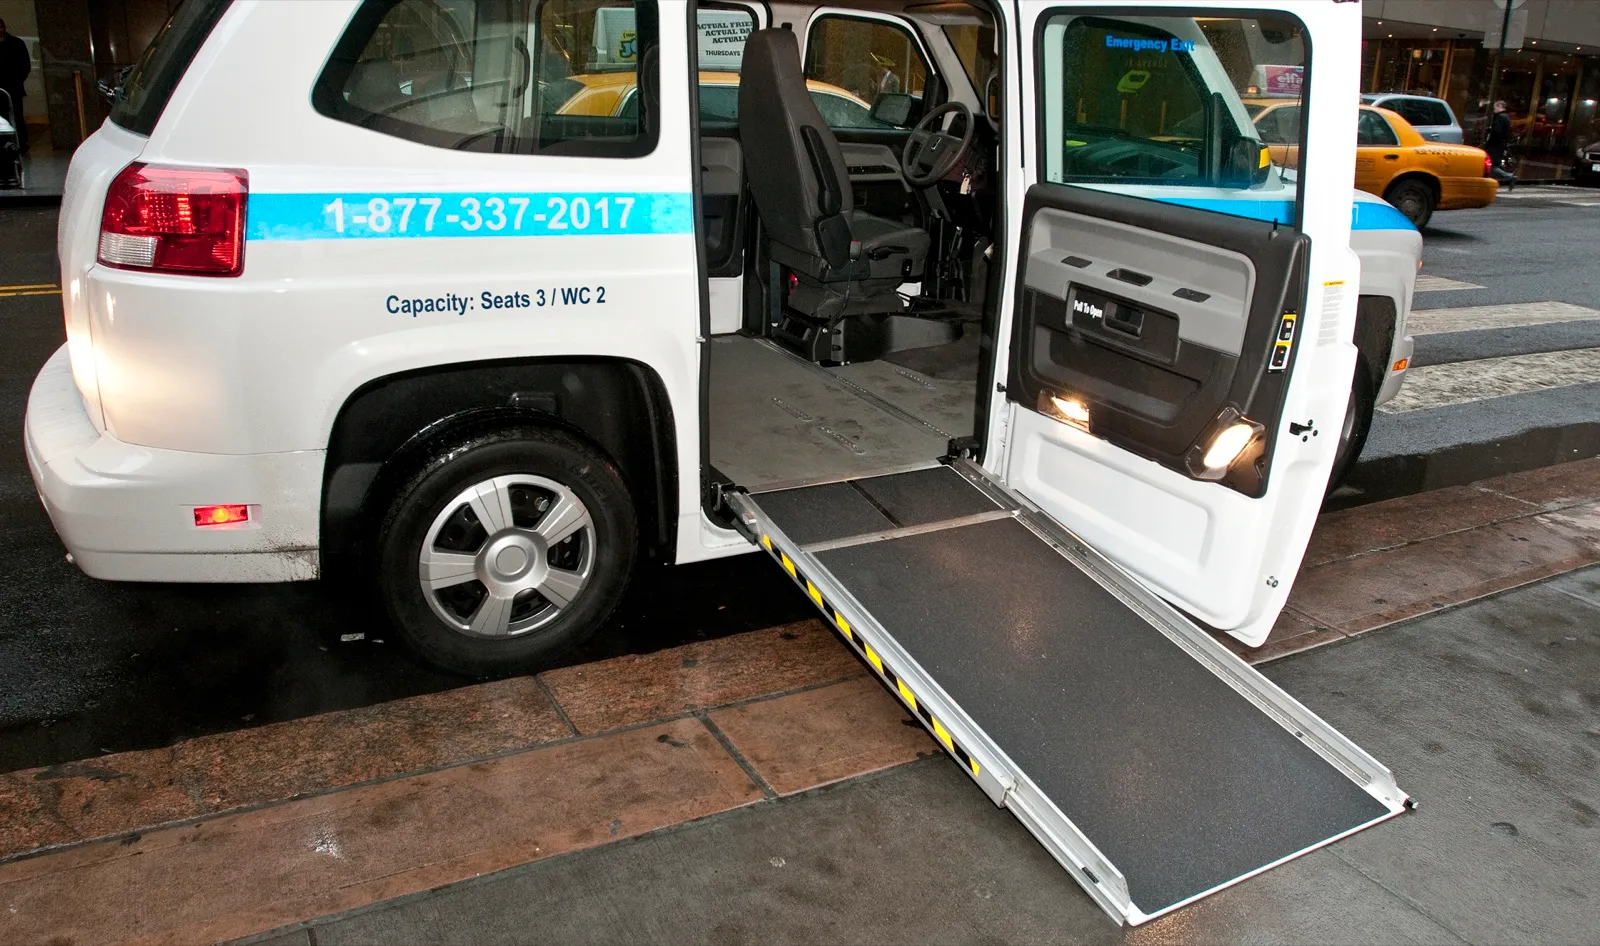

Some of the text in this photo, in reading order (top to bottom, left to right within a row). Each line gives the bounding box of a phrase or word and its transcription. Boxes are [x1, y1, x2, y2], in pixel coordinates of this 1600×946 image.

[1105, 34, 1195, 53] Emergency Exit
[325, 197, 636, 233] 1-877-337-2017
[386, 285, 606, 318] Capacity: Seats 3 / WC 2
[1073, 298, 1103, 318] Pull To Open
